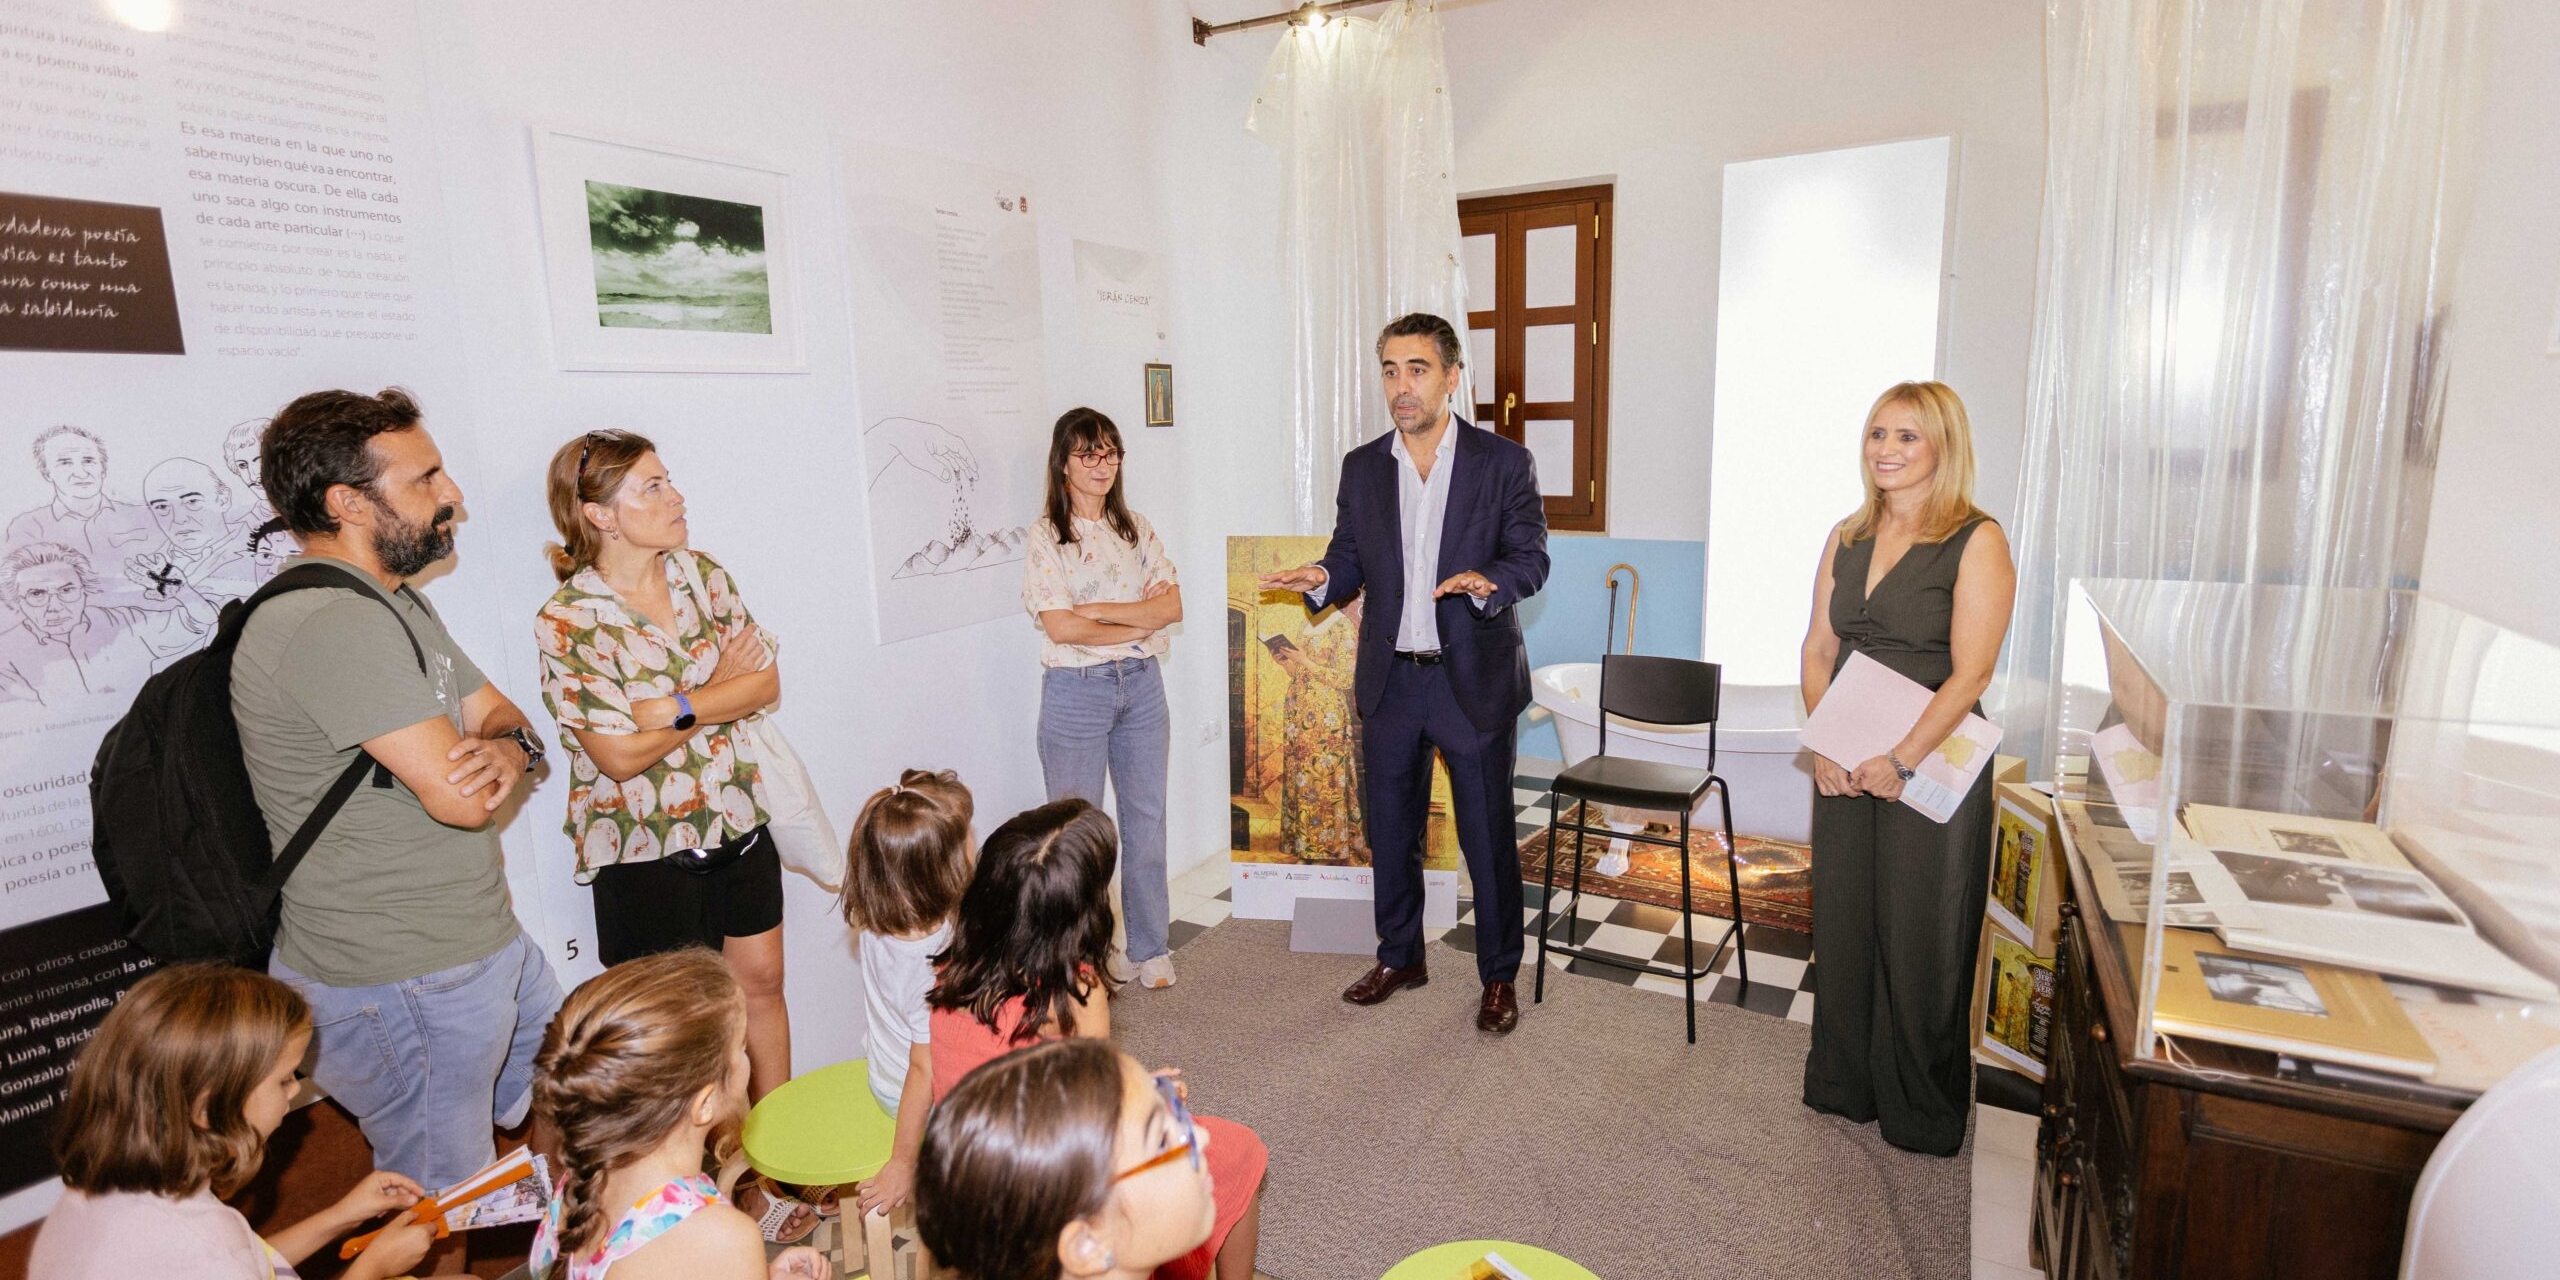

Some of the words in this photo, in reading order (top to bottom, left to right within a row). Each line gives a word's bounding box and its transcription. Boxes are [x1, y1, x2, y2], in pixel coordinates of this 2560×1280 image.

[60, 31, 121, 55] invisible
[125, 46, 136, 58] o
[14, 49, 33, 63] es
[37, 53, 90, 73] poema
[94, 63, 139, 81] visible
[180, 120, 197, 135] Es
[201, 126, 225, 140] esa
[229, 130, 281, 148] materia
[285, 138, 303, 151] en
[306, 138, 317, 153] la
[321, 143, 346, 159] que
[349, 148, 375, 162] uno
[377, 152, 394, 165] no
[184, 145, 218, 161] sabe
[220, 151, 251, 168] muy
[252, 152, 283, 169] bien
[283, 159, 309, 174] qué
[309, 163, 326, 175] va
[326, 165, 335, 176] a
[335, 166, 397, 186] encontrar,
[187, 168, 212, 182] esa
[217, 172, 270, 189] materia
[273, 179, 321, 195] oscura.
[323, 183, 342, 197] De
[345, 186, 368, 201] ella
[371, 190, 399, 205] cada
[192, 191, 221, 205] uno
[225, 195, 256, 209] saca
[260, 197, 290, 214] algo
[294, 202, 318, 215] con
[322, 204, 402, 225] instrumentos
[195, 211, 215, 226] de
[217, 215, 251, 229] cada
[253, 219, 281, 232] arte
[283, 222, 343, 239] particular
[83, 227, 141, 251] poesía
[47, 250, 65, 266] es
[73, 248, 128, 269] tanto
[281, 243, 302, 256] por
[305, 246, 333, 258] crear
[336, 248, 351, 260] es
[353, 248, 363, 261] la
[262, 262, 314, 276] absoluto
[317, 266, 334, 278] de
[336, 266, 363, 280] toda
[41, 277, 91, 291] como
[99, 281, 142, 294] una
[293, 285, 340, 300] primero
[340, 289, 362, 301] que
[20, 296, 119, 320] sabiduría
[248, 302, 279, 316] todo
[3, 770, 88, 799] oscuridad
[47, 799, 66, 813] de
[5, 833, 25, 845] en
[32, 851, 43, 861] o
[5, 868, 61, 894] poesía
[65, 865, 76, 876] o
[567, 938, 579, 961] 5
[2, 966, 31, 983] con
[36, 954, 74, 973] otros
[36, 975, 93, 1001] intensa,
[94, 965, 121, 983] con
[123, 961, 137, 974] la
[30, 993, 114, 1031] Rebeyrolle,
[8, 1044, 51, 1067] Luna,
[1, 1066, 65, 1095] Gonzalo
